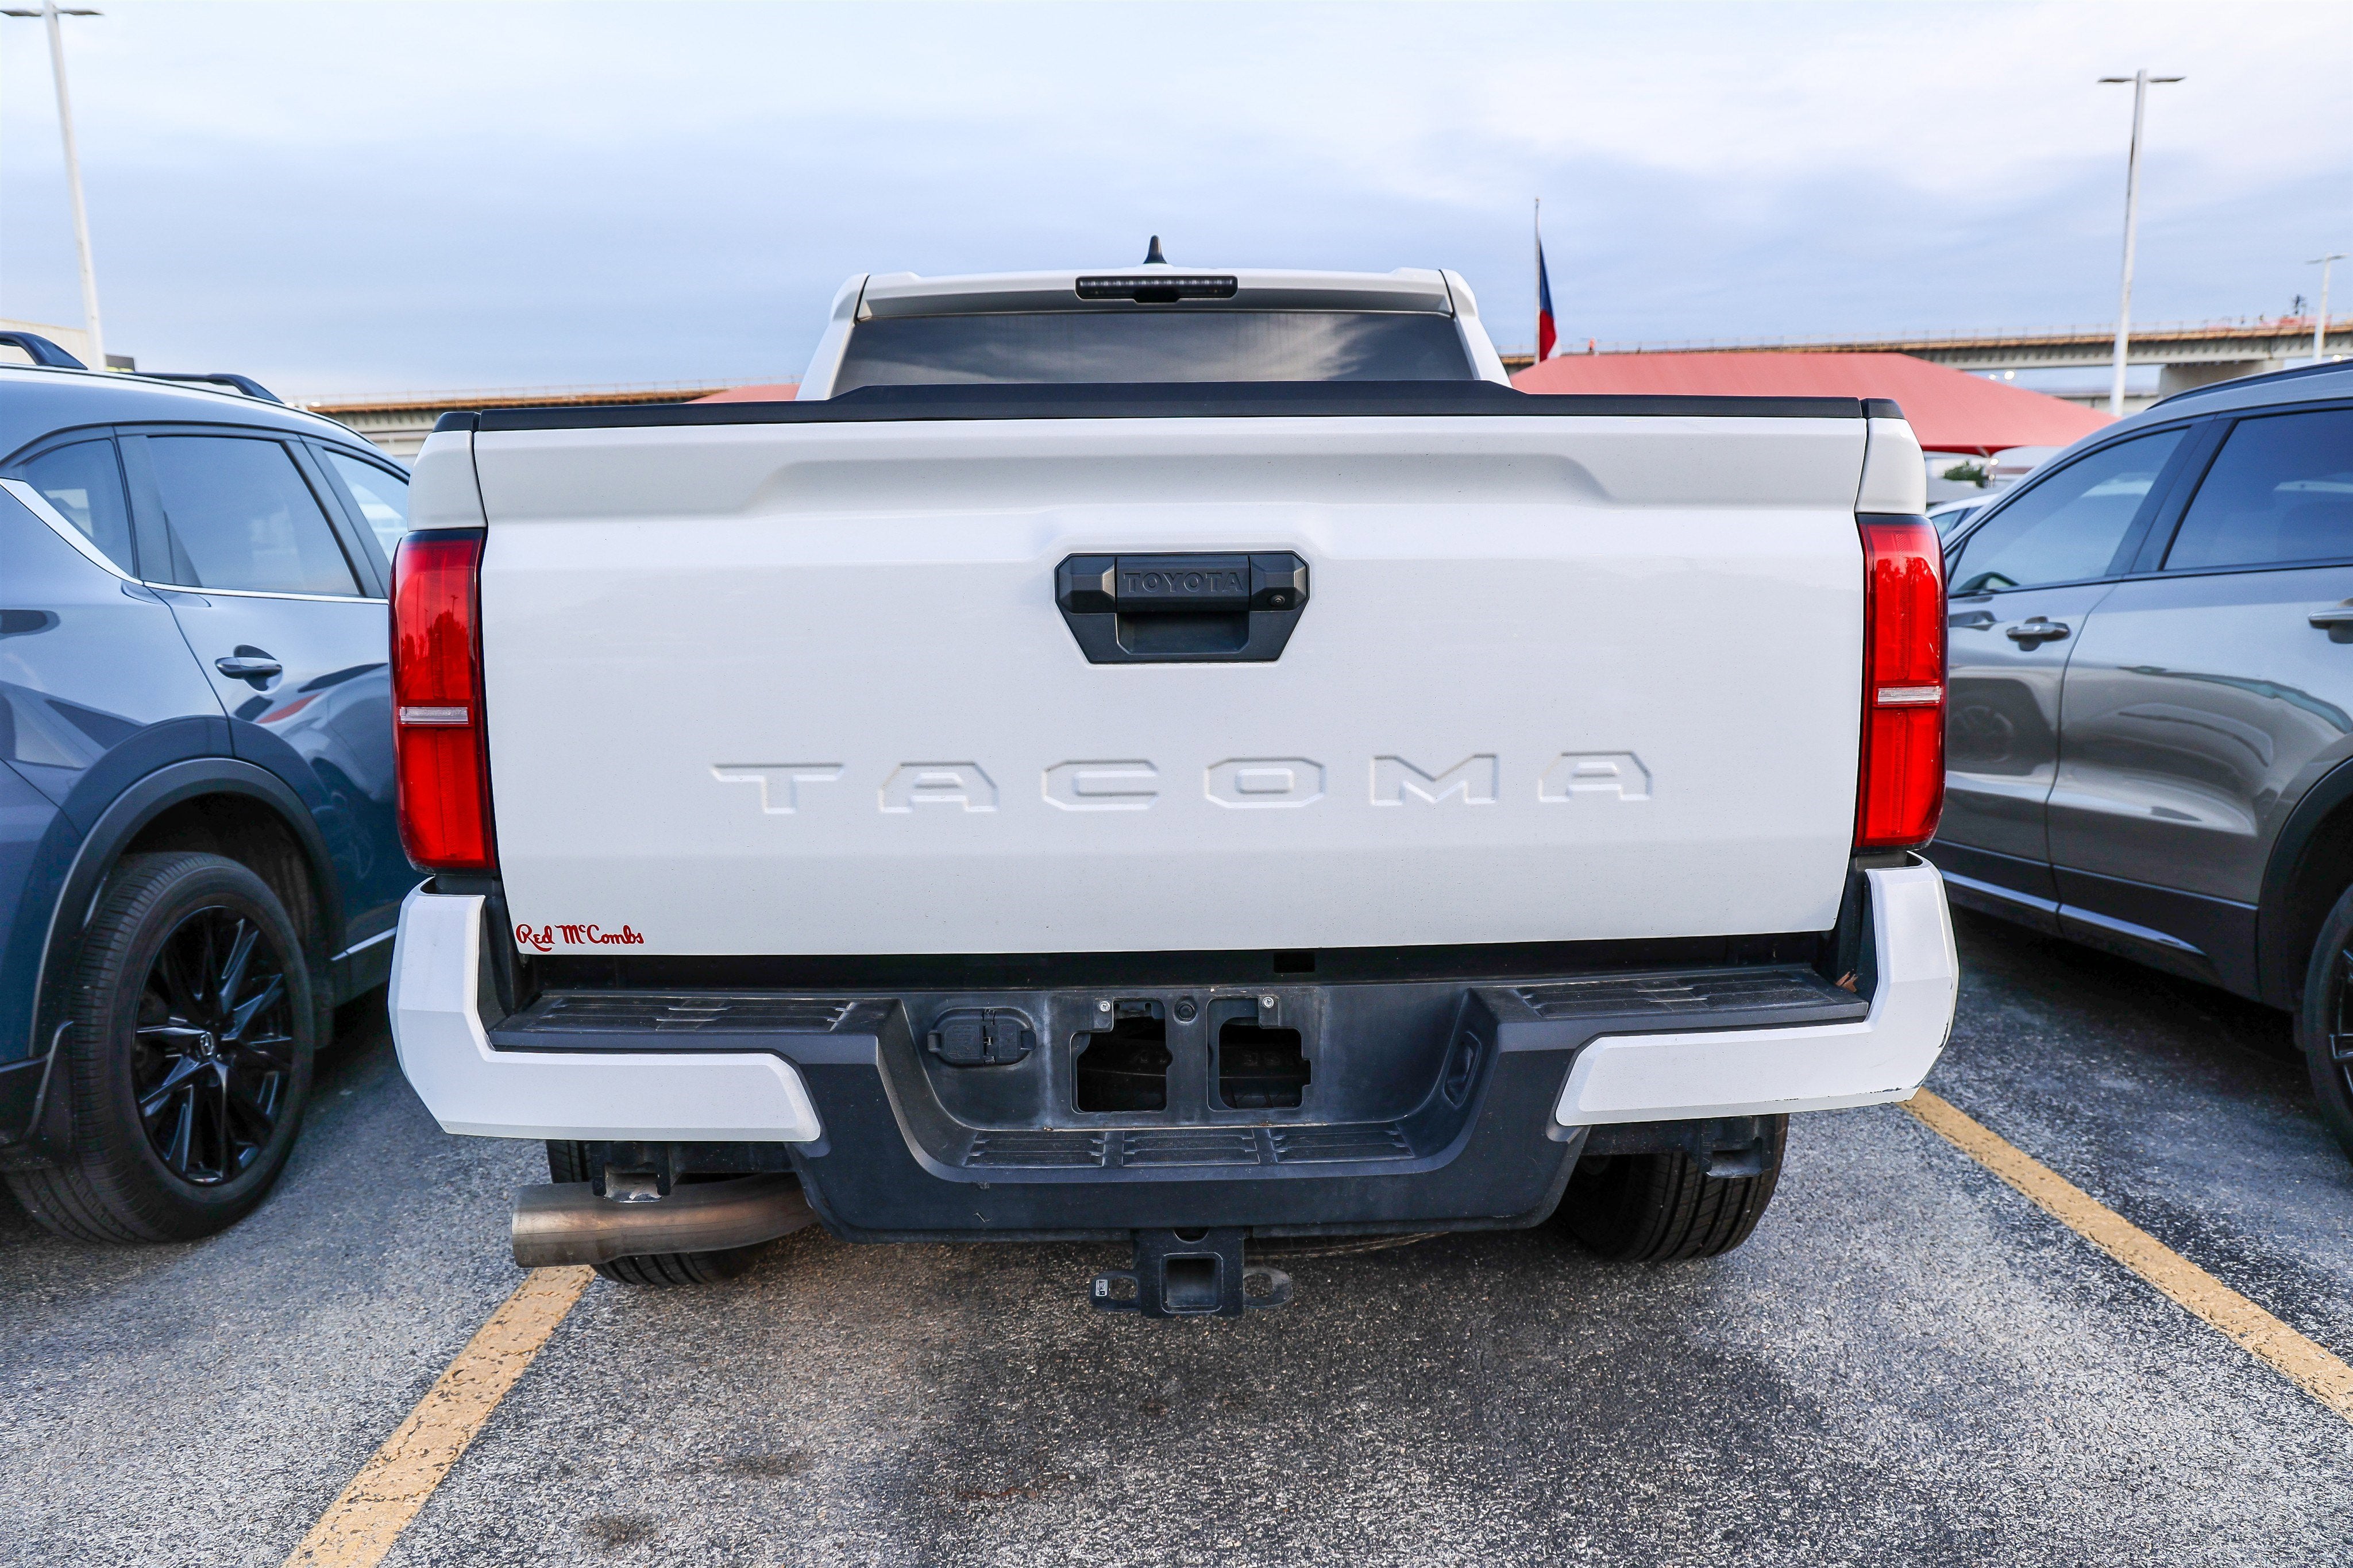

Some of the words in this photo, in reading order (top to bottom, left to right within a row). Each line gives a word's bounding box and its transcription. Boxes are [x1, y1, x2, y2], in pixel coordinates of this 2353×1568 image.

[1124, 572, 1243, 593] TOYOTA
[711, 751, 1652, 814] TACOMA
[516, 924, 556, 952] Red
[554, 924, 645, 944] McCombs
